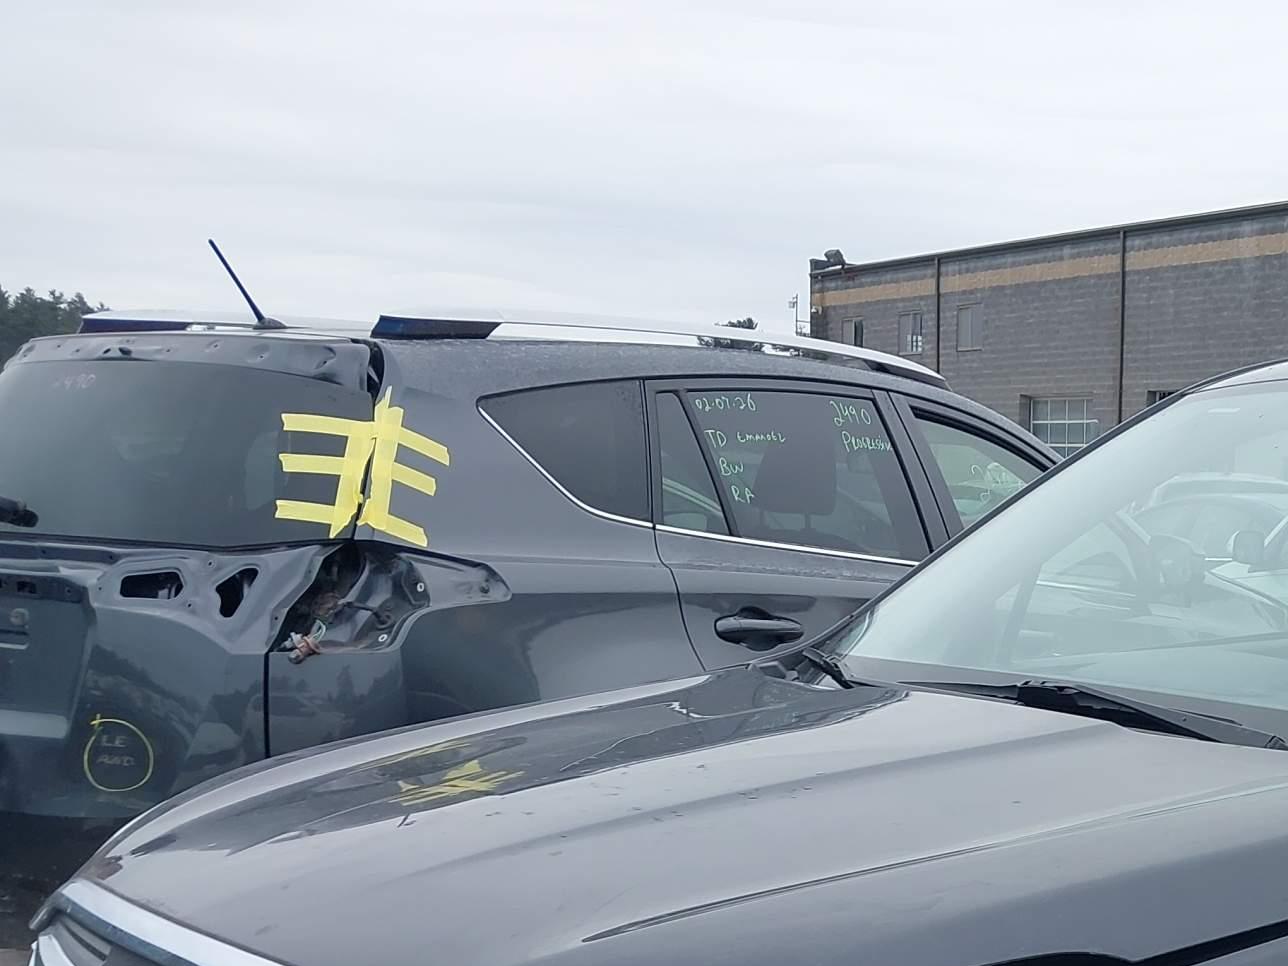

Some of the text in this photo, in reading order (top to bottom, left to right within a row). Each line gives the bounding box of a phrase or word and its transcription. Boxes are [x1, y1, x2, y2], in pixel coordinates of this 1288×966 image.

[829, 400, 871, 427] 2490
[703, 429, 728, 449] TD
[731, 485, 755, 504] RA
